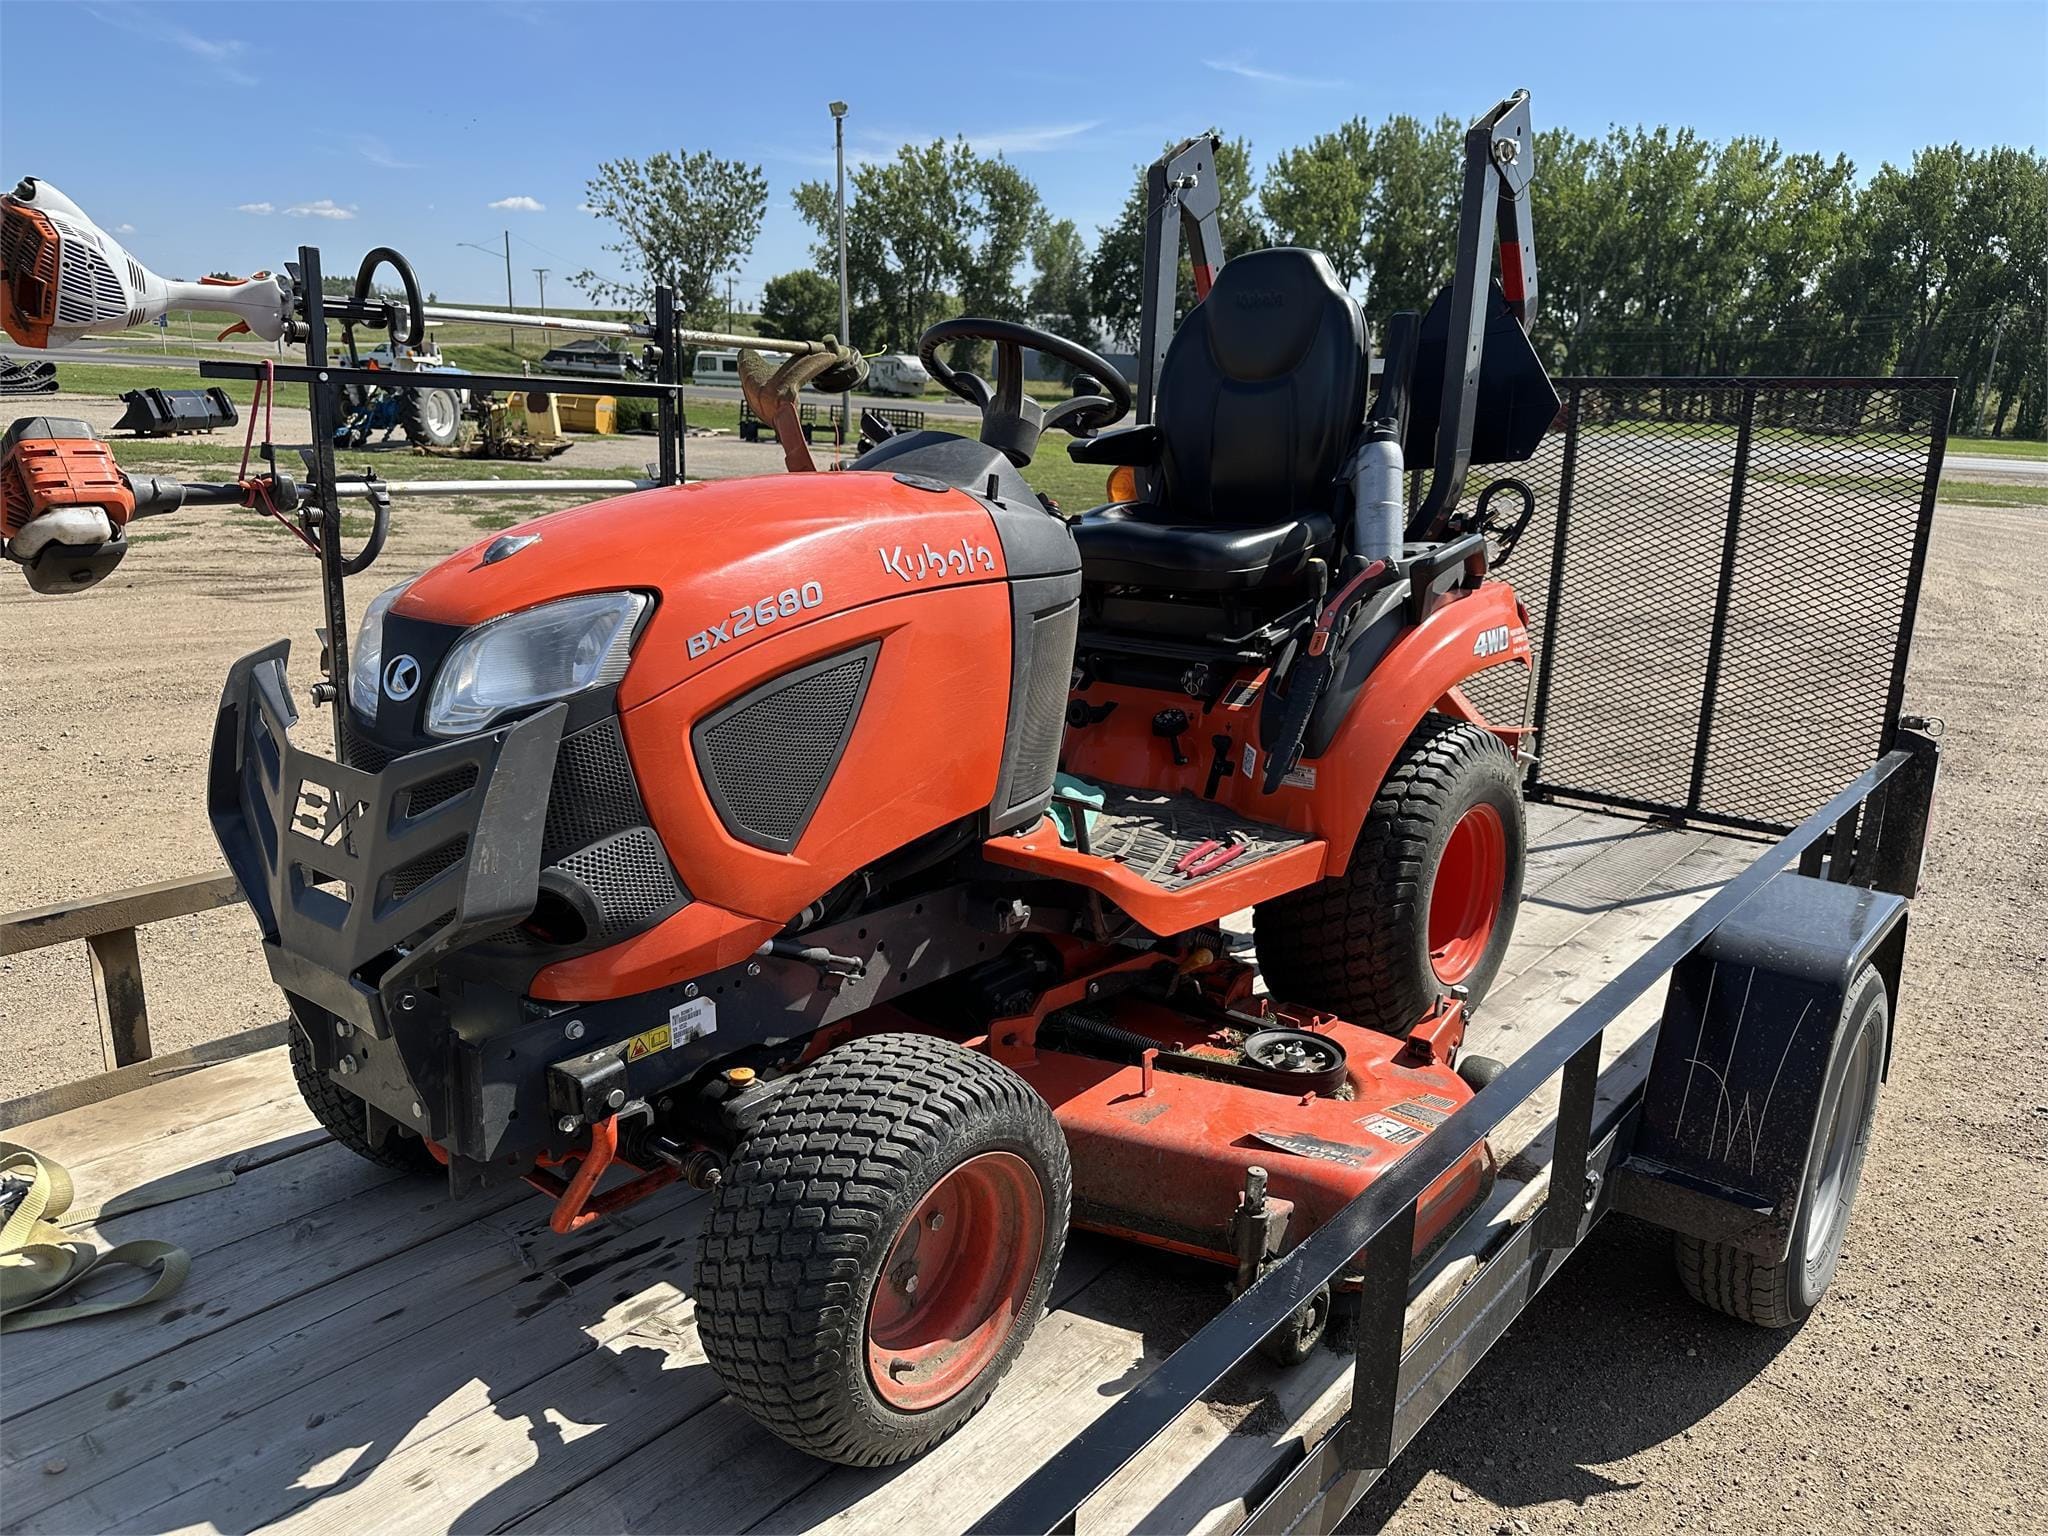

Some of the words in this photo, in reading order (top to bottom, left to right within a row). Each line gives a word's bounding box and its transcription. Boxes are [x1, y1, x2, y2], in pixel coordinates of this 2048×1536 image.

[878, 538, 995, 583] Kubota
[685, 580, 824, 661] BX2680
[1473, 624, 1509, 658] 4WD
[290, 779, 370, 858] BX
